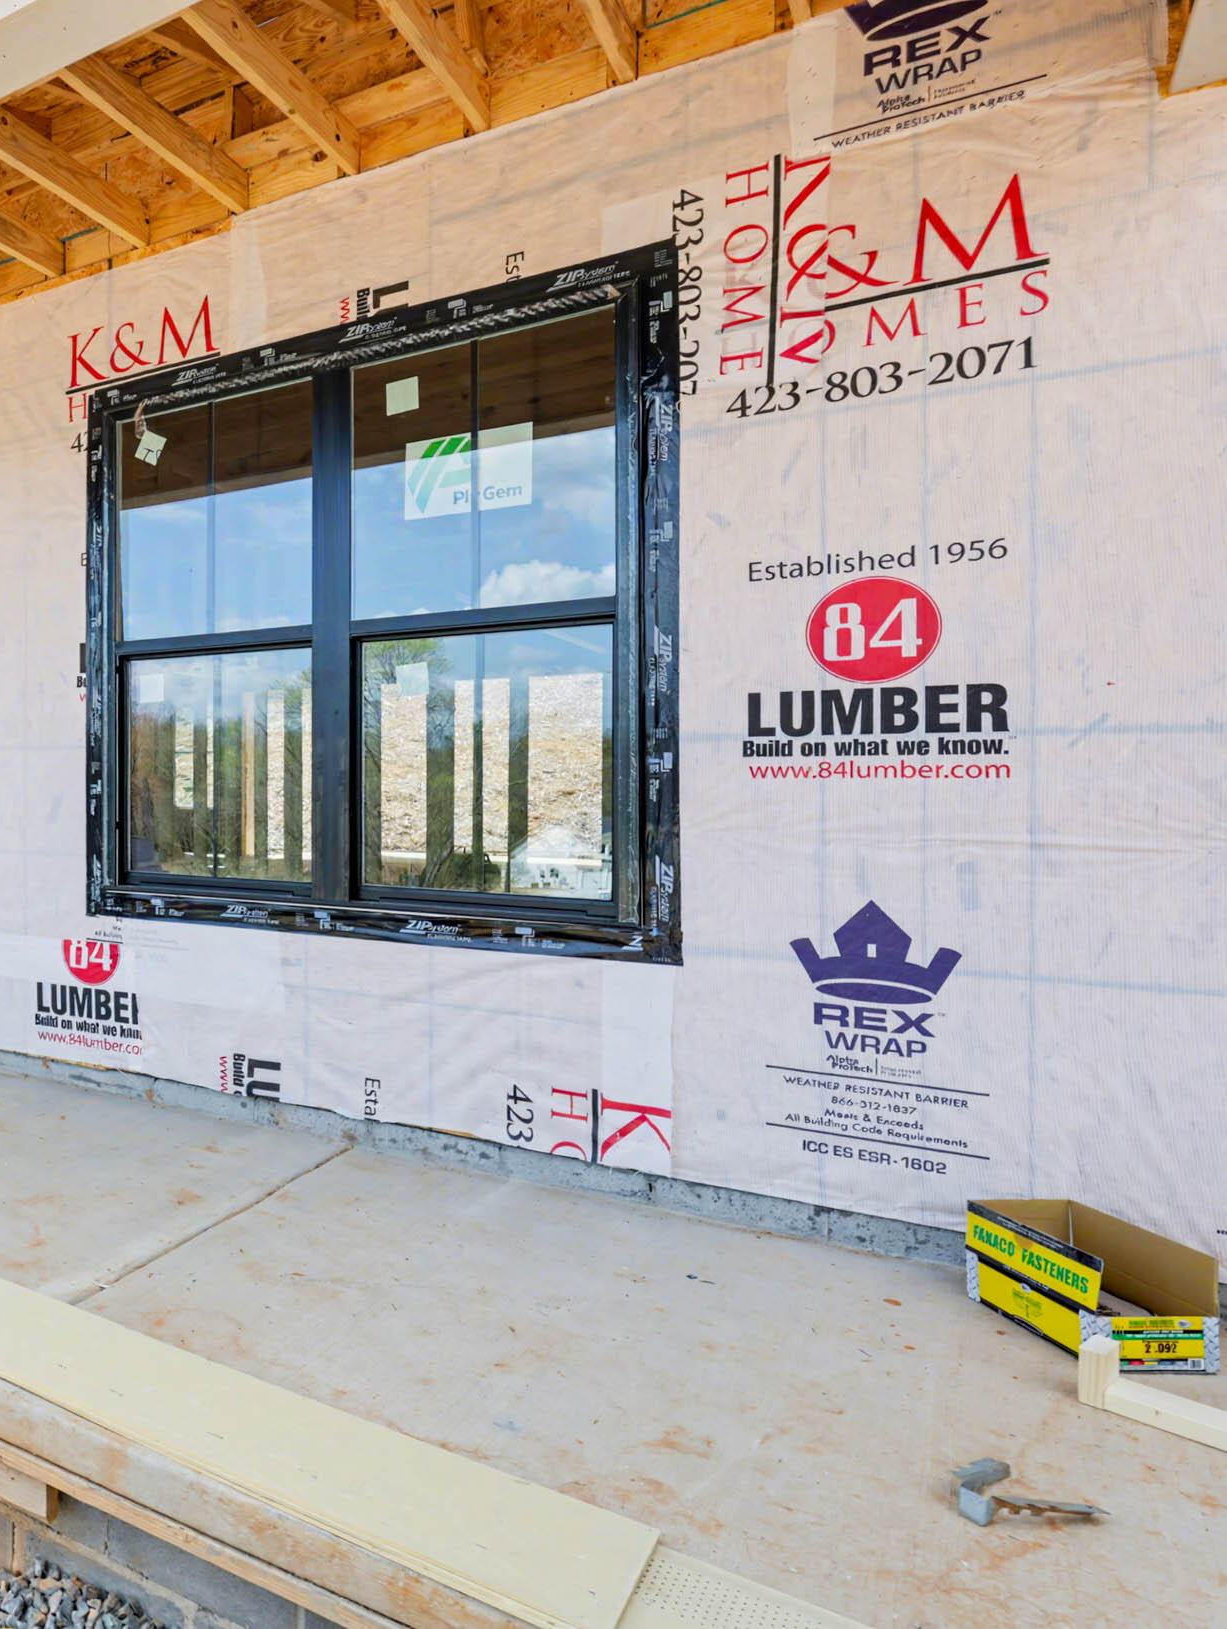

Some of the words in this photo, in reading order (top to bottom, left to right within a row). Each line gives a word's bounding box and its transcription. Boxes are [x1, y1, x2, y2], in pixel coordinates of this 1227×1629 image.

[864, 16, 990, 76] REX
[875, 49, 982, 95] WRAP
[832, 126, 891, 148] WEATHER
[896, 105, 965, 131] RESISTANT
[970, 90, 1025, 112] BARRIER
[67, 295, 220, 389] K&M
[725, 335, 1038, 419] 423-803-2071
[453, 488, 480, 505] Pl
[483, 485, 522, 501] Gem
[748, 545, 917, 582] Established
[929, 537, 1009, 566] 1956
[823, 597, 923, 661] 84
[747, 683, 1010, 737] LUMBER
[742, 739, 793, 757] Build
[801, 742, 827, 757] on
[834, 739, 889, 757] what
[896, 740, 930, 755] we
[938, 737, 1009, 756] know.
[748, 760, 1011, 780] www.84lumber.com
[35, 1013, 58, 1027] Build
[61, 1019, 72, 1030] on
[76, 1020, 99, 1034] what
[102, 1024, 117, 1037] we
[813, 1002, 935, 1038] REX
[38, 1031, 142, 1055] www.84lumber.co
[824, 1030, 927, 1058] WRAP
[831, 1061, 873, 1073] ProTech
[364, 1077, 381, 1122] Esta
[783, 1075, 840, 1091] WEATHER
[845, 1084, 910, 1100] RESISTANT
[915, 1093, 969, 1109] BARRIER
[831, 1096, 917, 1115] 866-312-1837
[785, 1113, 801, 1123] All
[803, 1115, 848, 1132] Building
[852, 1123, 883, 1135] Code
[887, 1128, 968, 1149] Requirements
[824, 1108, 858, 1121] Meets
[863, 1113, 872, 1123] &
[876, 1116, 924, 1130] Exceeds
[802, 1139, 829, 1155] ICC
[833, 1145, 853, 1159] ES
[973, 1224, 1015, 1257] FANACO
[1021, 1248, 1089, 1294] FASTENERS
